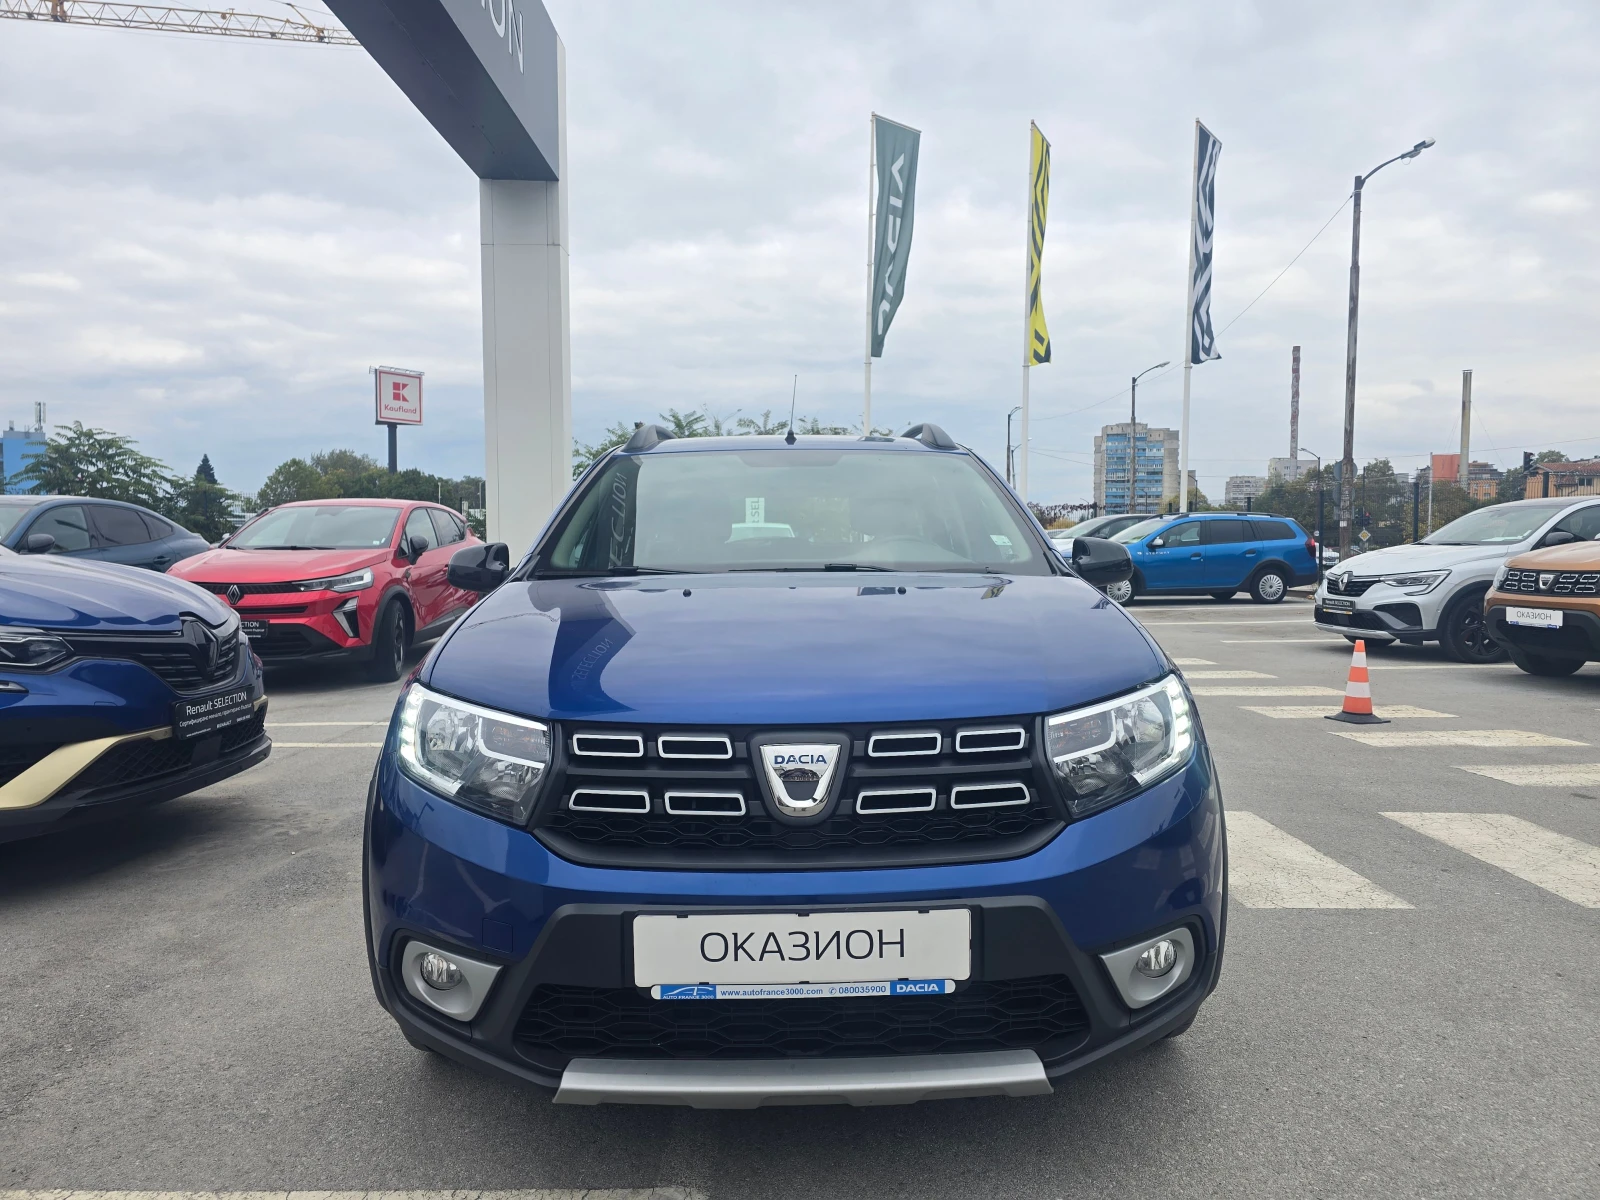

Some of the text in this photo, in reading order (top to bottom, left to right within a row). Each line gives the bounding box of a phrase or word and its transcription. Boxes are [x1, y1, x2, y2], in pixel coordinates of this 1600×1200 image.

[384, 403, 417, 414] Kaufland
[1516, 611, 1552, 620] ОКАЗИОН
[186, 700, 213, 716] Renault
[213, 691, 247, 709] SELECTION
[774, 754, 827, 764] DACIA
[700, 928, 905, 962] ОКАЗИОН
[720, 985, 887, 996] www.autofrance3000.com 080035900
[896, 983, 939, 993] DACIA
